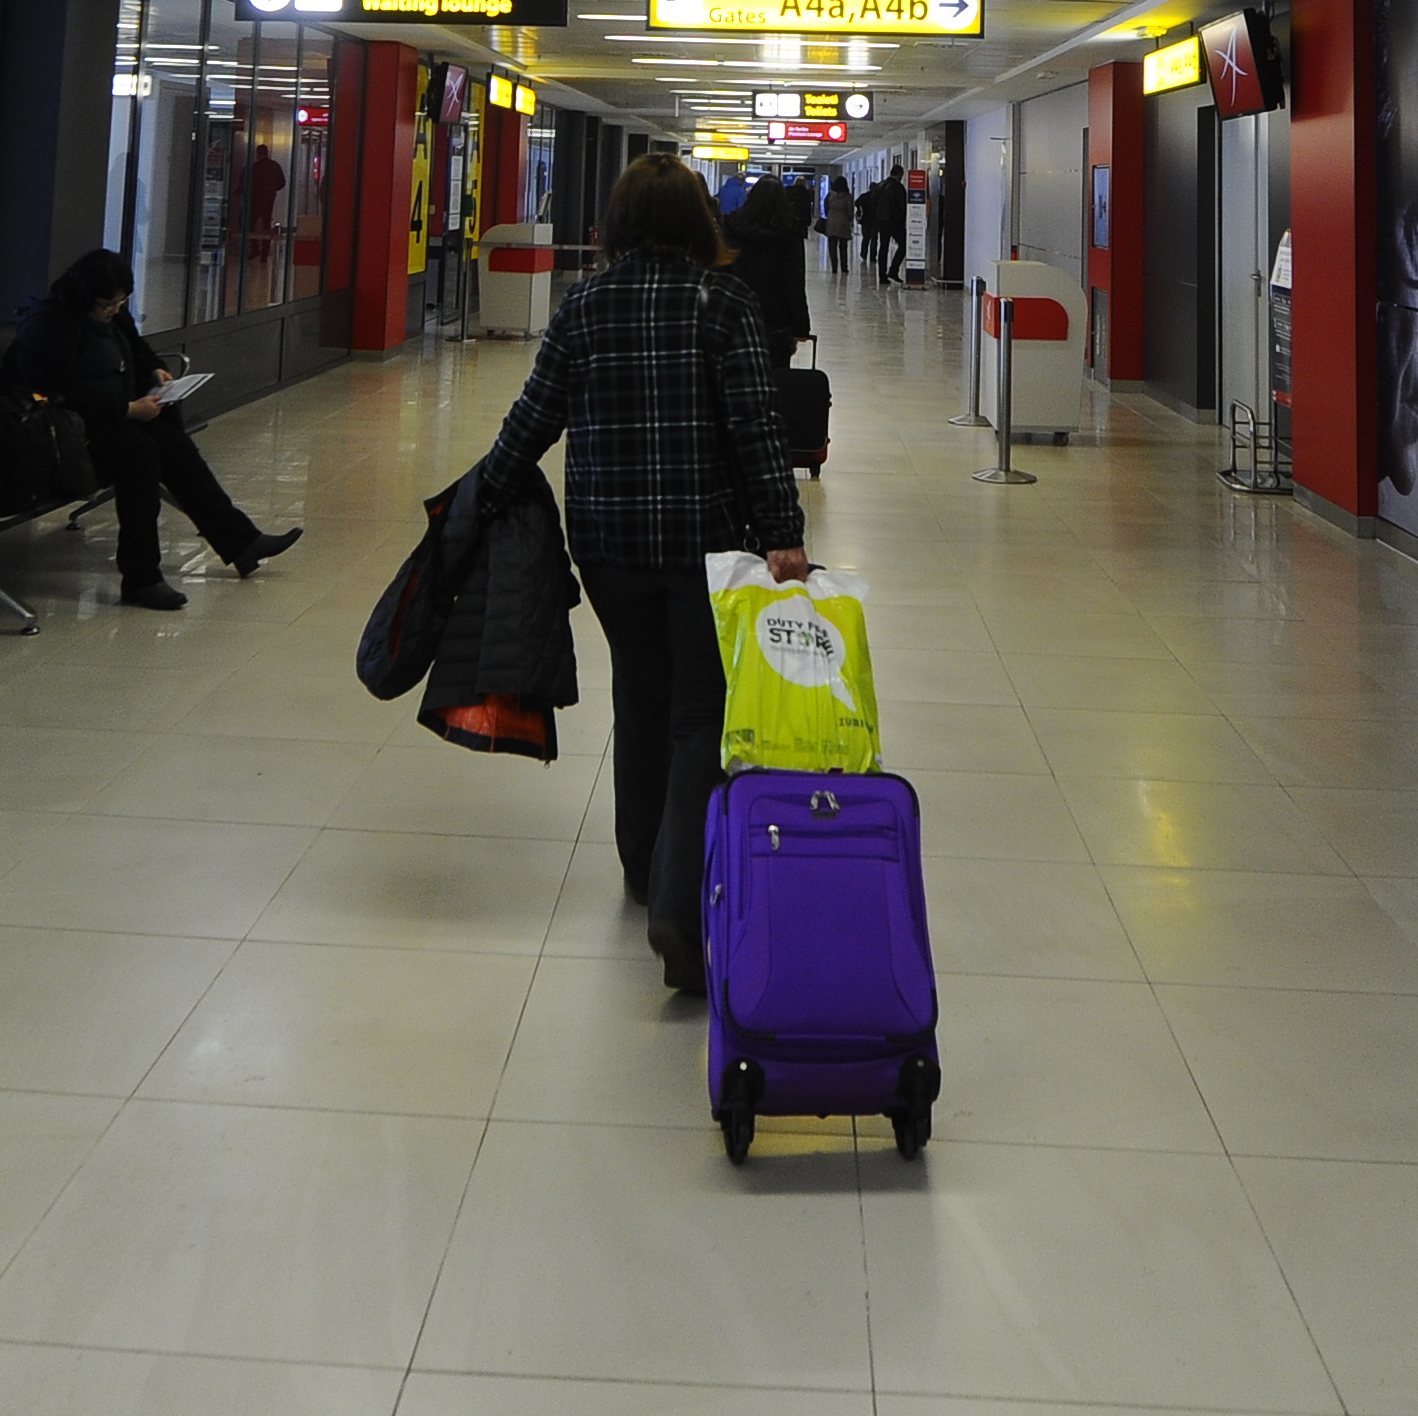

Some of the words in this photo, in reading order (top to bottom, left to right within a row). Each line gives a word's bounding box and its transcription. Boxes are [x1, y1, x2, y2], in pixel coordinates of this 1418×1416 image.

[709, 7, 766, 24] Gates
[411, 180, 423, 244] 4
[767, 618, 803, 629] DUTY
